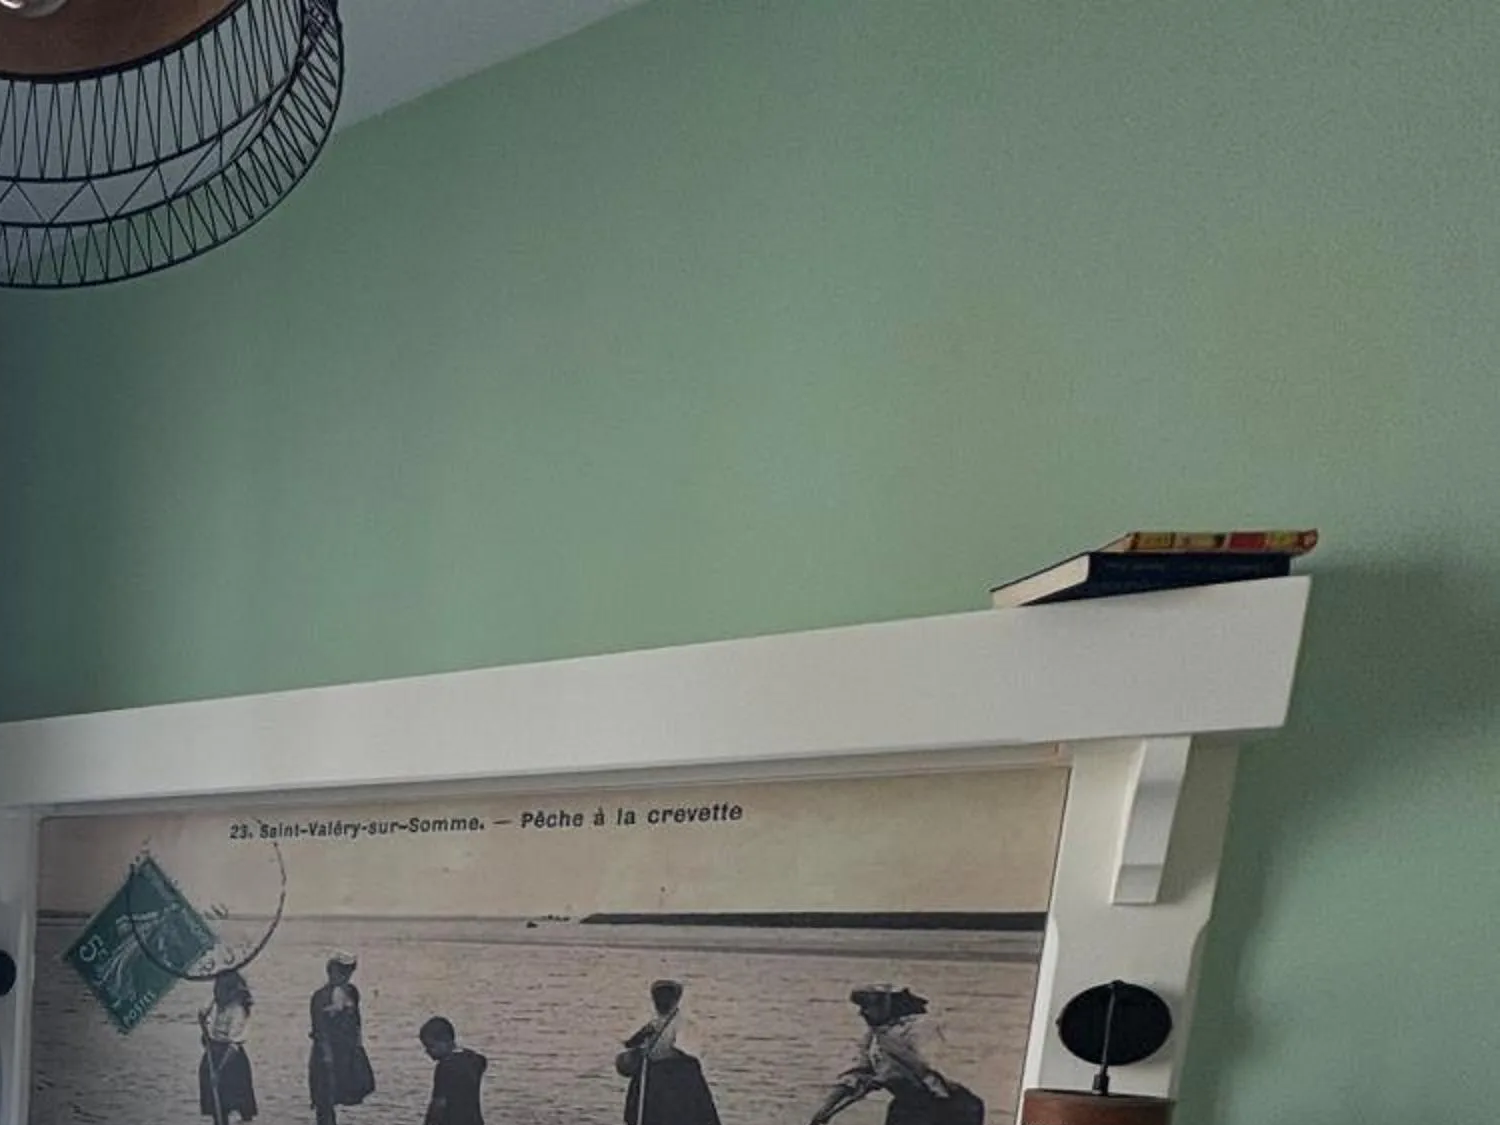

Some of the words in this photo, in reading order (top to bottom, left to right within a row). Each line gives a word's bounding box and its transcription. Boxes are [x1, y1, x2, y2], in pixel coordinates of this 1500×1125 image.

[229, 823, 254, 840] 23.
[521, 809, 585, 829] Pêche
[593, 806, 606, 826] à
[617, 807, 637, 826] la
[647, 802, 744, 825] crevette
